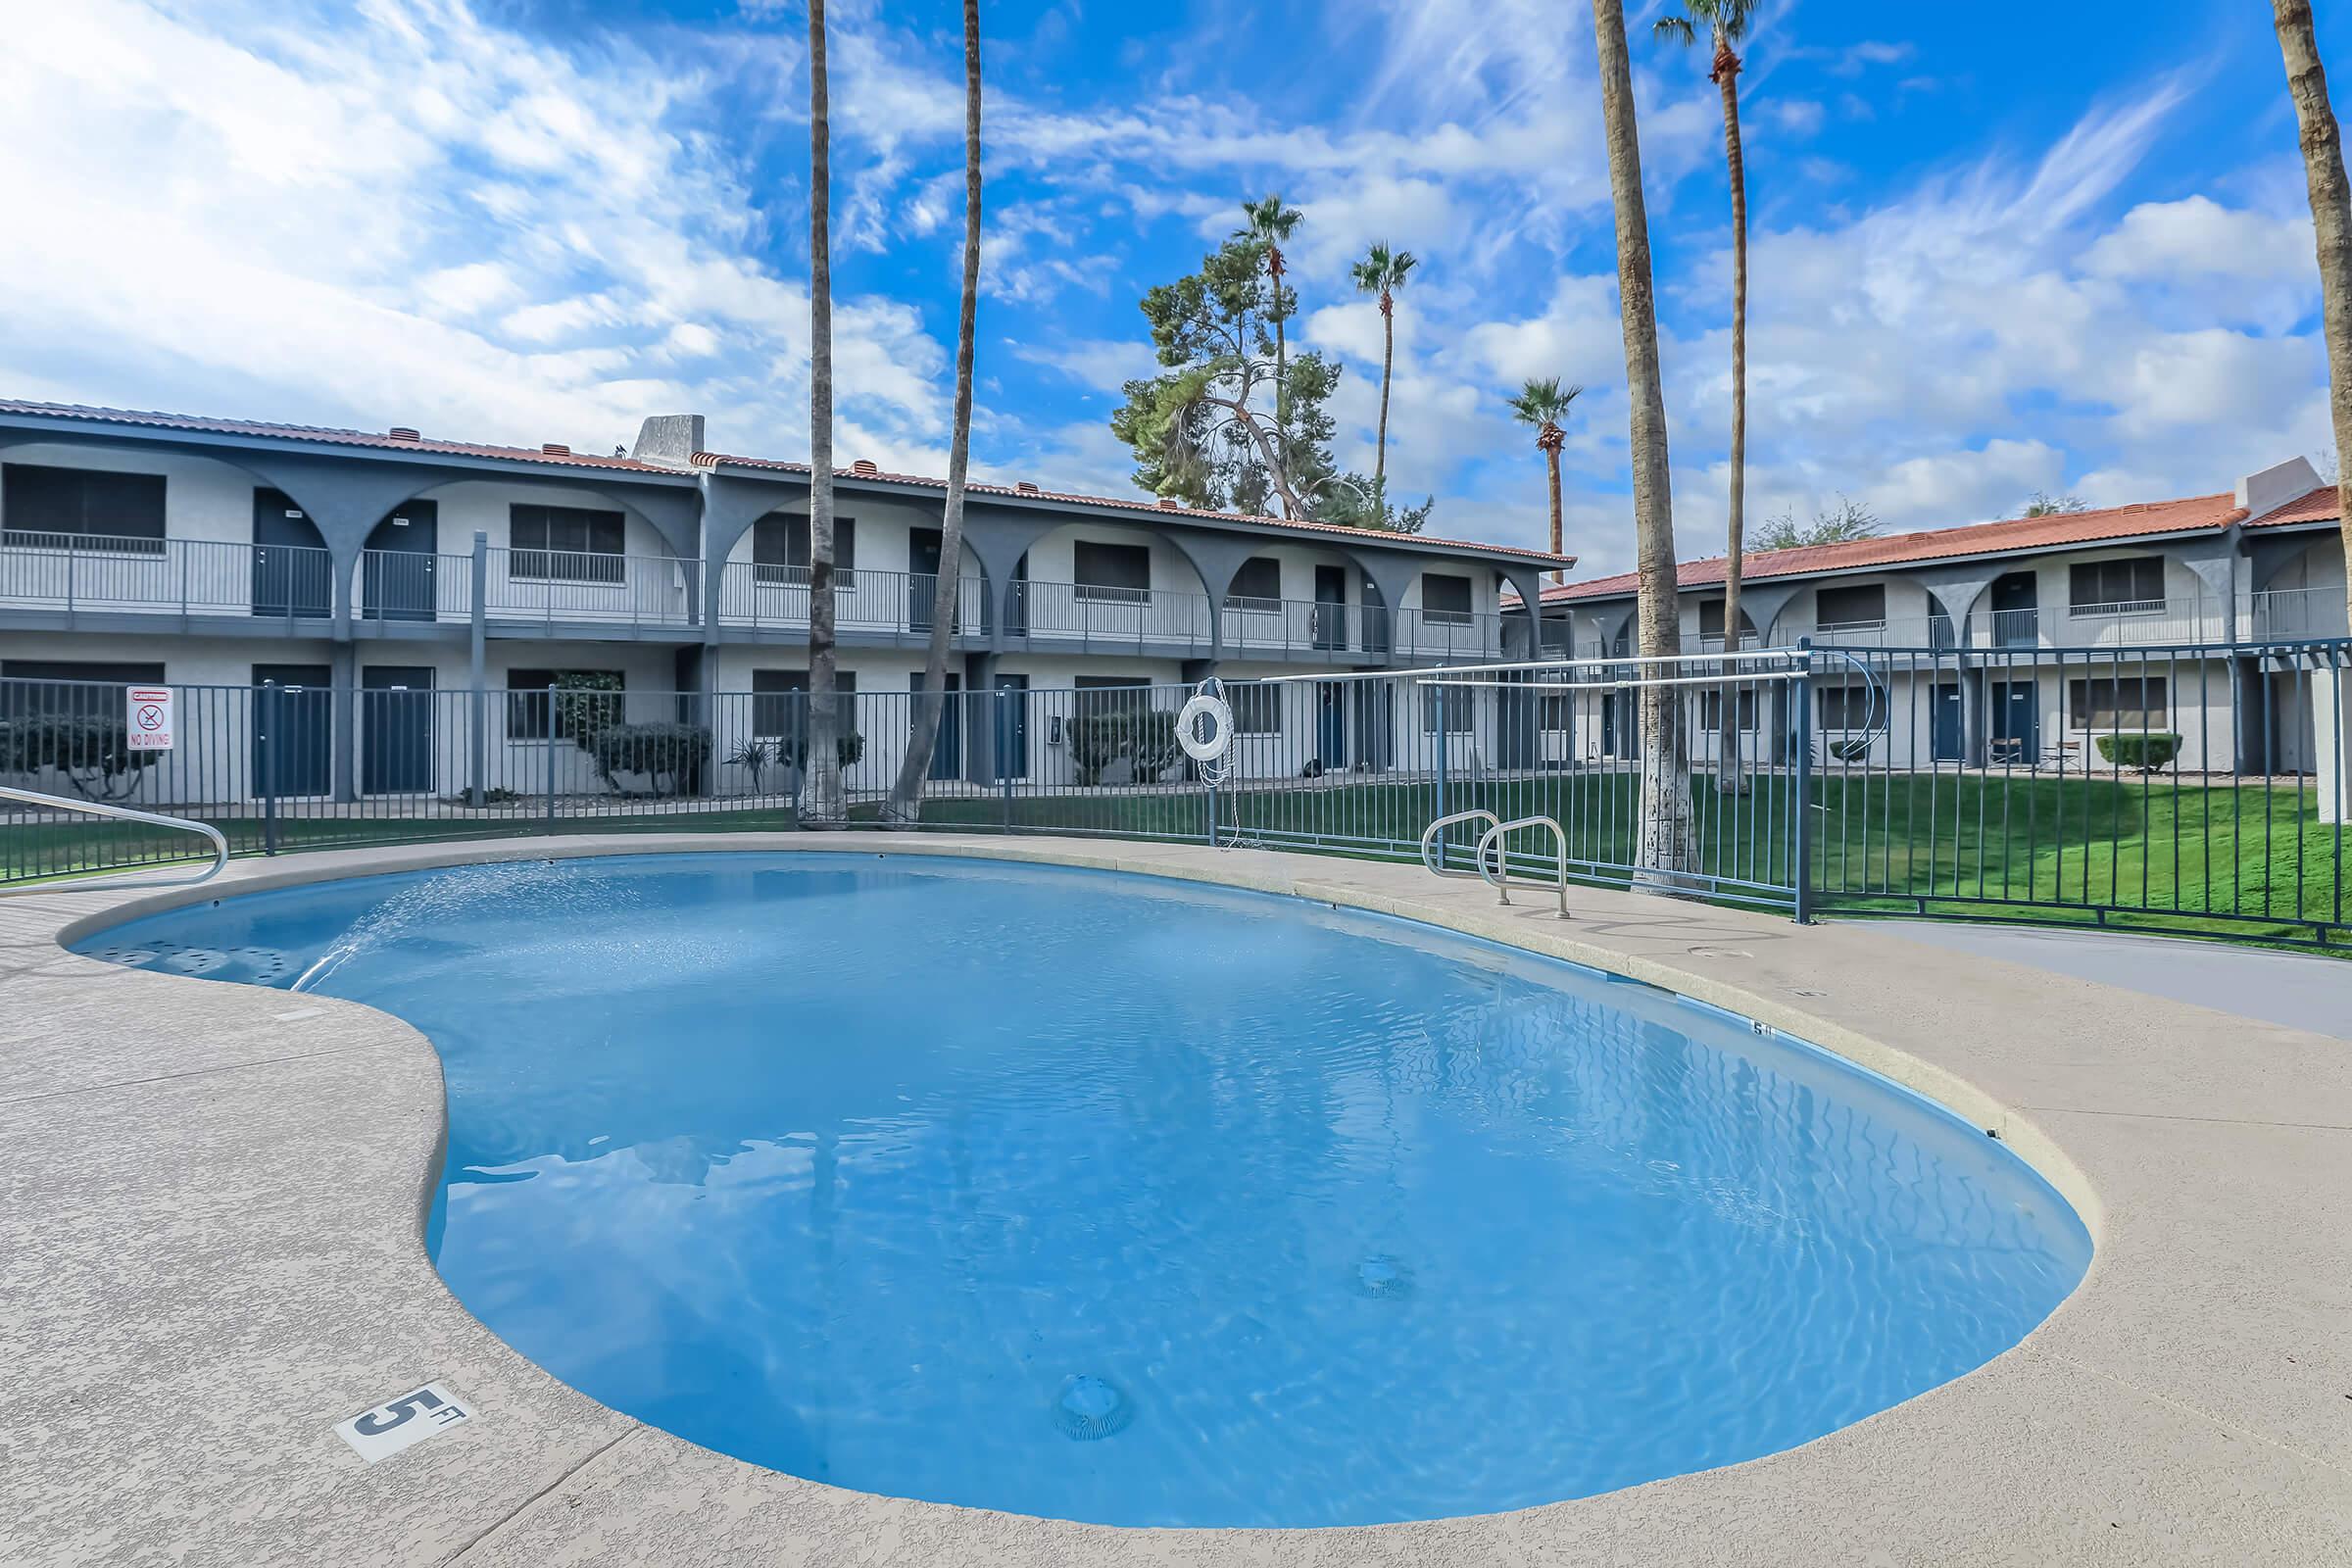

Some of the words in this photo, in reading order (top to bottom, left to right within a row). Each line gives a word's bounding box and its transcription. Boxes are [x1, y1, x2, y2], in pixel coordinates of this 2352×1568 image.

[131, 734, 141, 746] NO
[144, 734, 170, 746] DIVING
[1754, 1021, 1762, 1035] 5
[354, 1389, 444, 1436] 5
[429, 1405, 466, 1425] FT
